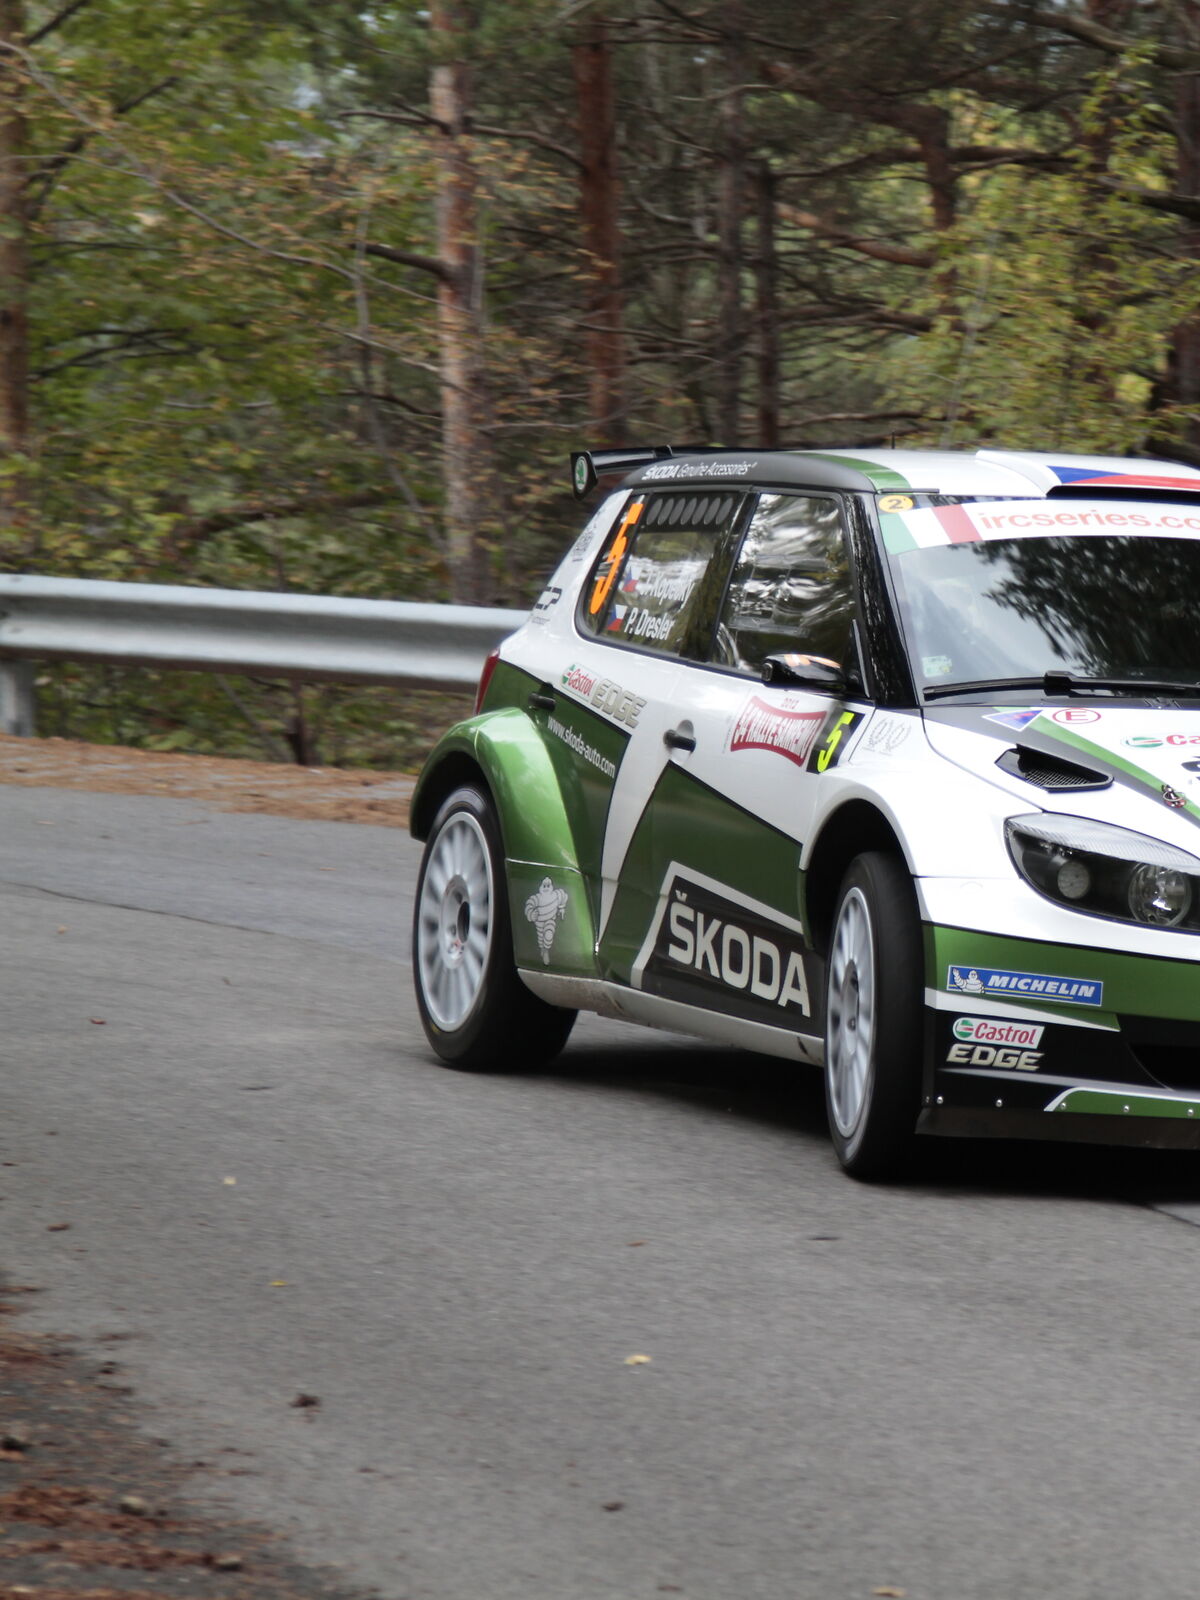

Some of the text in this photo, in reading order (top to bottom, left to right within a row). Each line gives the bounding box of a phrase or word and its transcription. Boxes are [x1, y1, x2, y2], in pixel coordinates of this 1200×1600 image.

[634, 609, 676, 641] Dresler
[567, 668, 647, 729] Castrol EDGE
[1066, 711, 1088, 721] E
[547, 715, 616, 779] www.skoda-auto.com
[817, 711, 855, 773] 5
[668, 889, 811, 1018] ŠKODA
[986, 975, 1097, 998] MICHELIN
[974, 1021, 1036, 1046] Castrol
[945, 1044, 1045, 1072] EDGE
